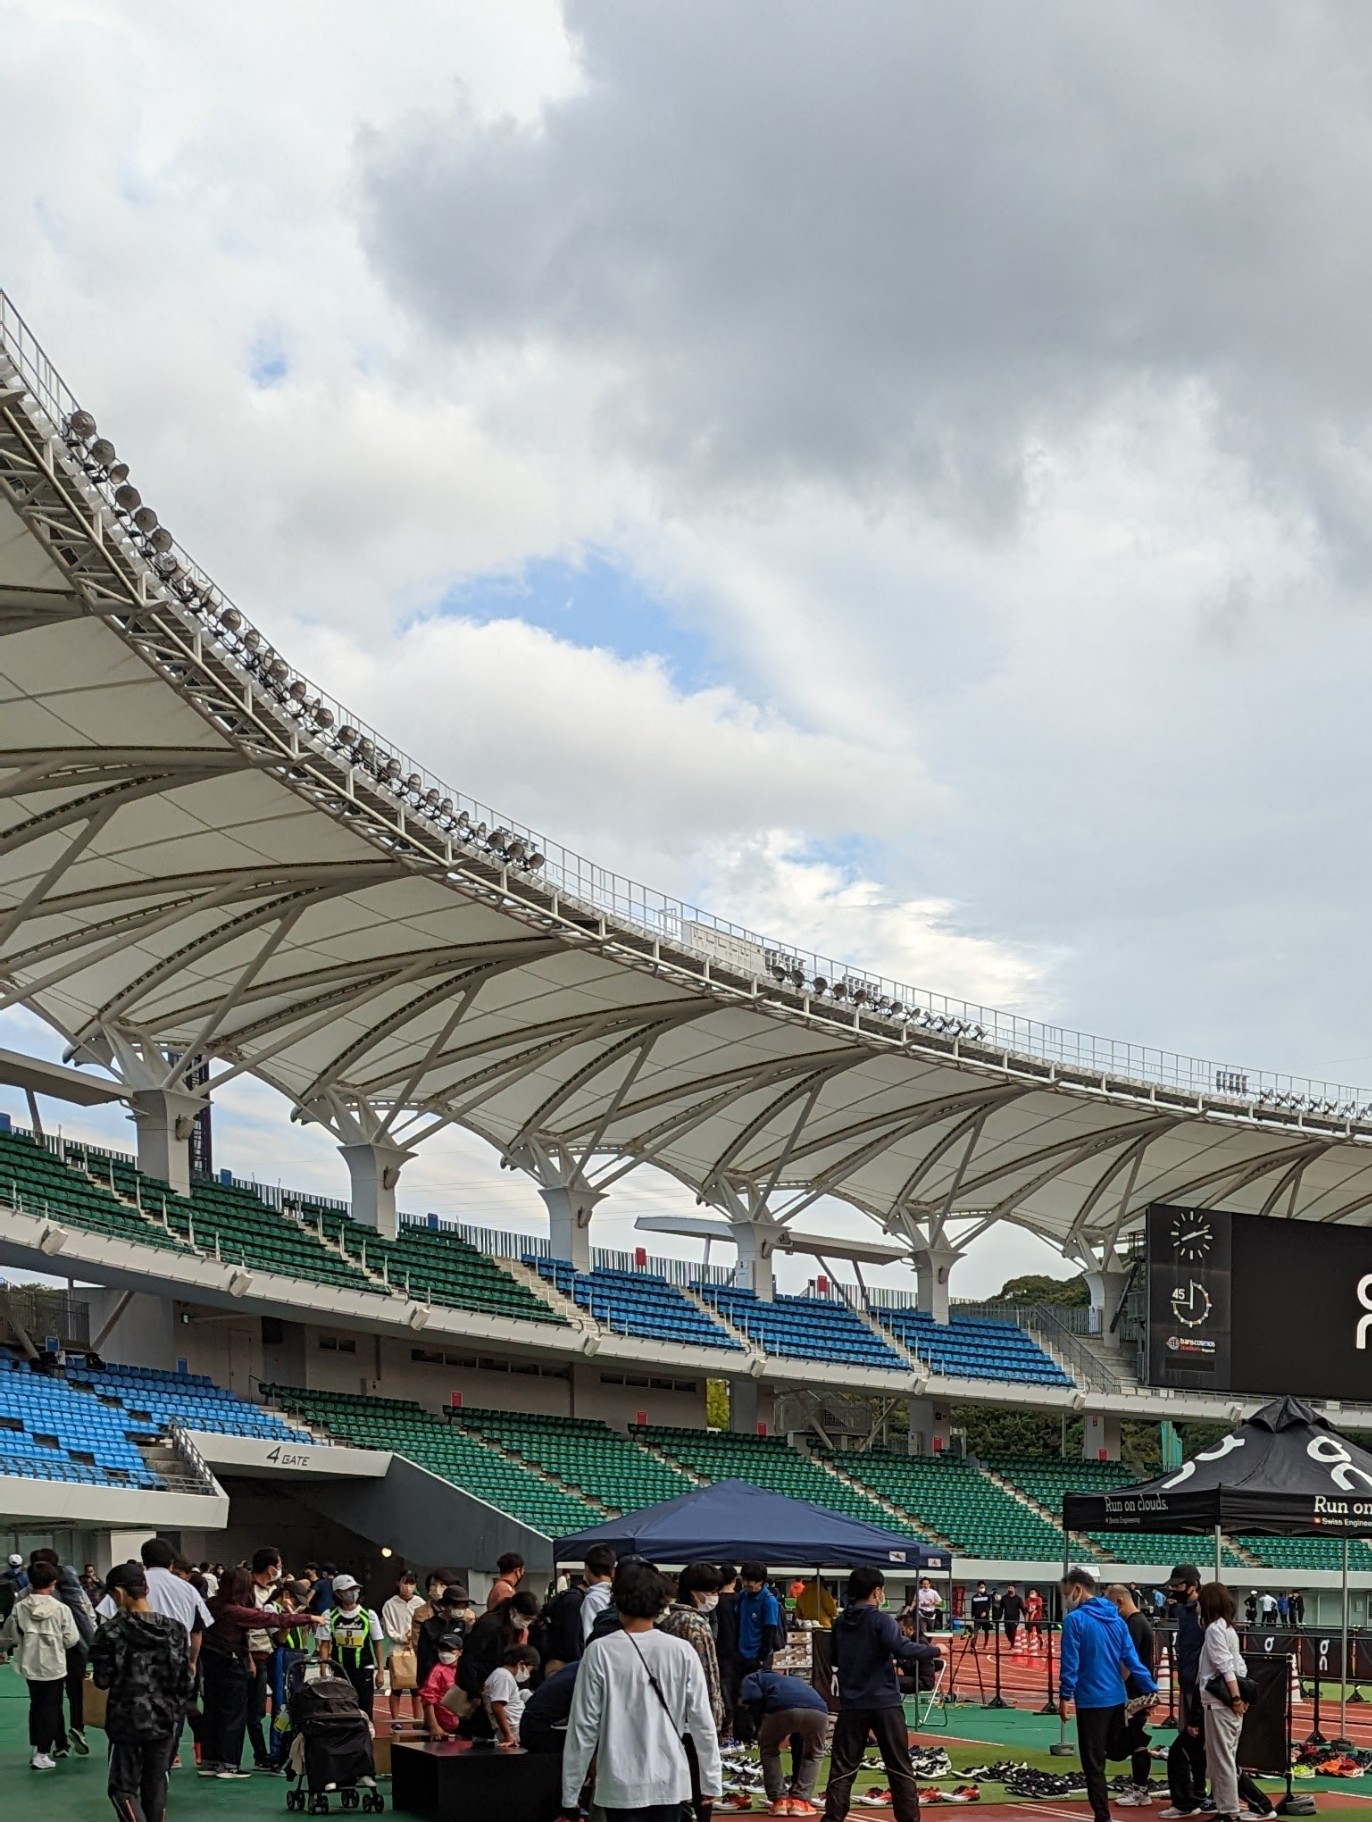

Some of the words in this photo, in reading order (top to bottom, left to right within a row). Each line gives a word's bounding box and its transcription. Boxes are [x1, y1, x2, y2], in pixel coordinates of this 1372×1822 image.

[1172, 1288, 1186, 1300] 45
[266, 1446, 282, 1464] 4
[281, 1454, 311, 1467] GATE
[1104, 1496, 1123, 1512] Run
[1124, 1501, 1136, 1512] on
[1137, 1493, 1169, 1511] clouds.
[1314, 1496, 1349, 1513] Run
[1322, 1517, 1343, 1526] Swiss
